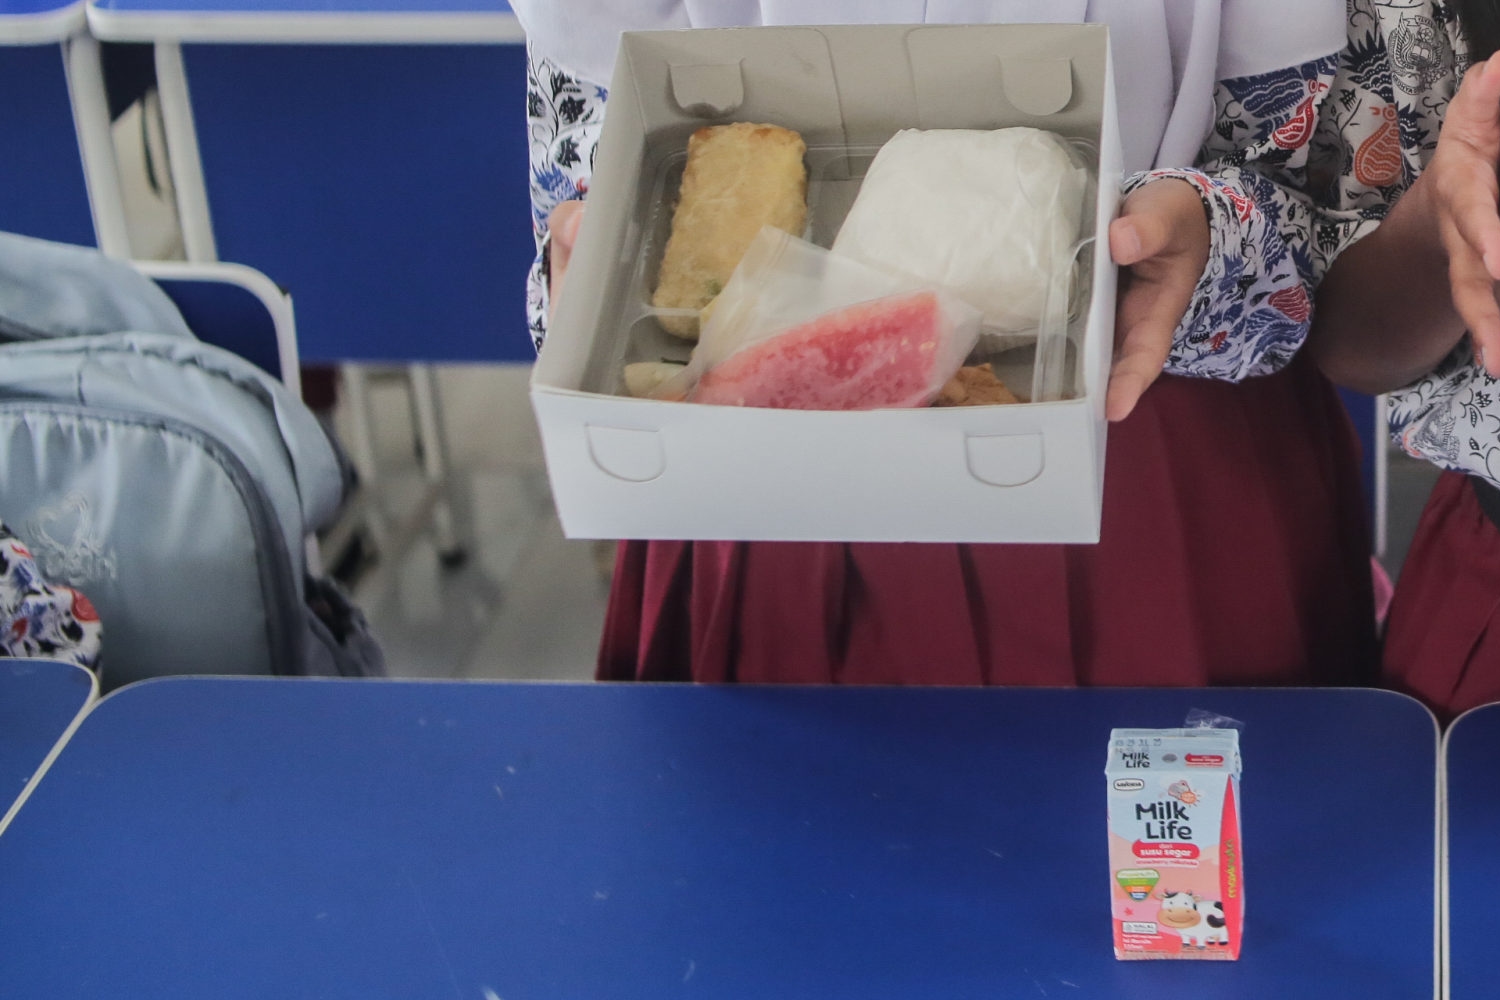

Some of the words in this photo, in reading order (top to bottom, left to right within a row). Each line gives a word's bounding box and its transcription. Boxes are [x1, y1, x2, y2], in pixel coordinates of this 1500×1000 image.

[1122, 752, 1149, 761] Milk
[1125, 760, 1151, 769] Life
[1135, 801, 1190, 821] Milk
[1146, 820, 1193, 840] Life
